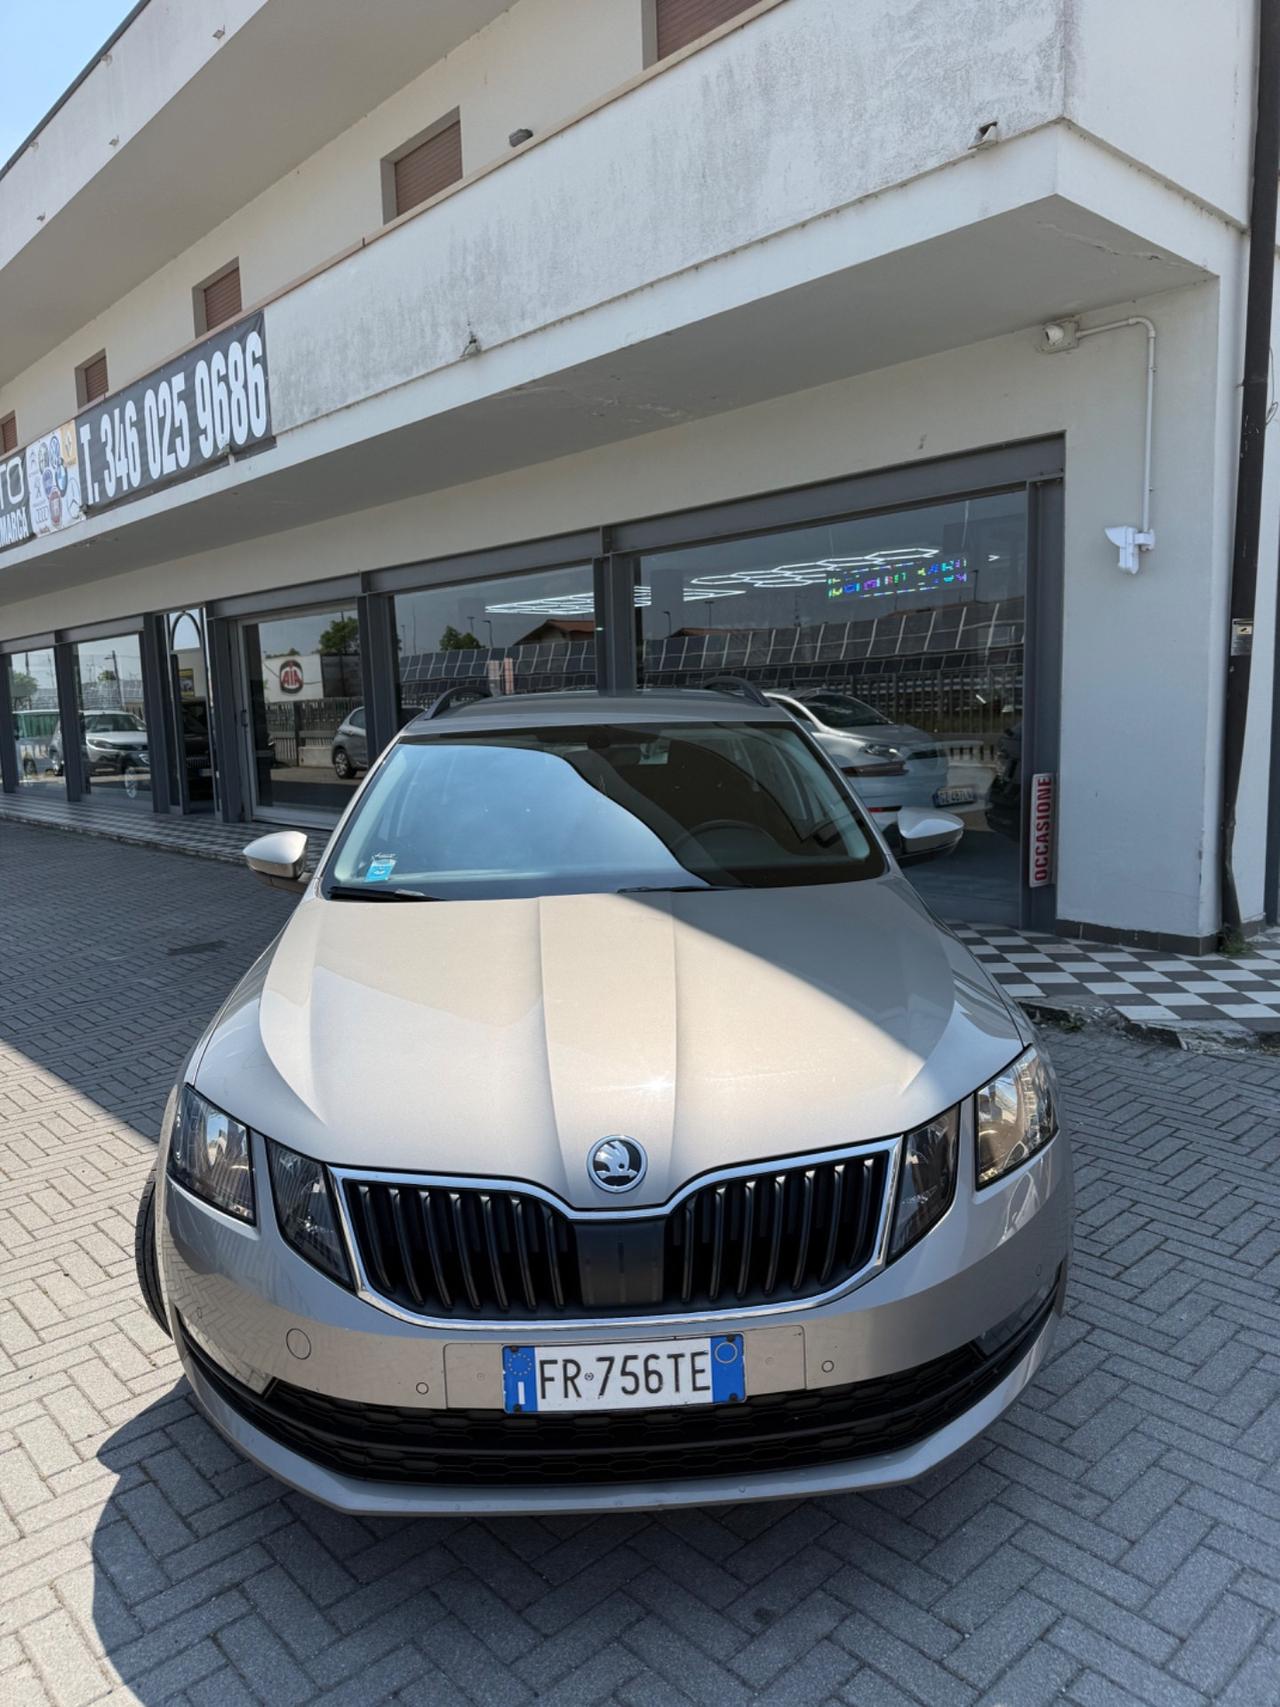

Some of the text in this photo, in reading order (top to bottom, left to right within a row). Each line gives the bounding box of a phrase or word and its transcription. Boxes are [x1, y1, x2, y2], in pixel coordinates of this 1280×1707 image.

[80, 331, 267, 505] T. 346 025 9686
[1035, 777, 1052, 881] OCCASIONE
